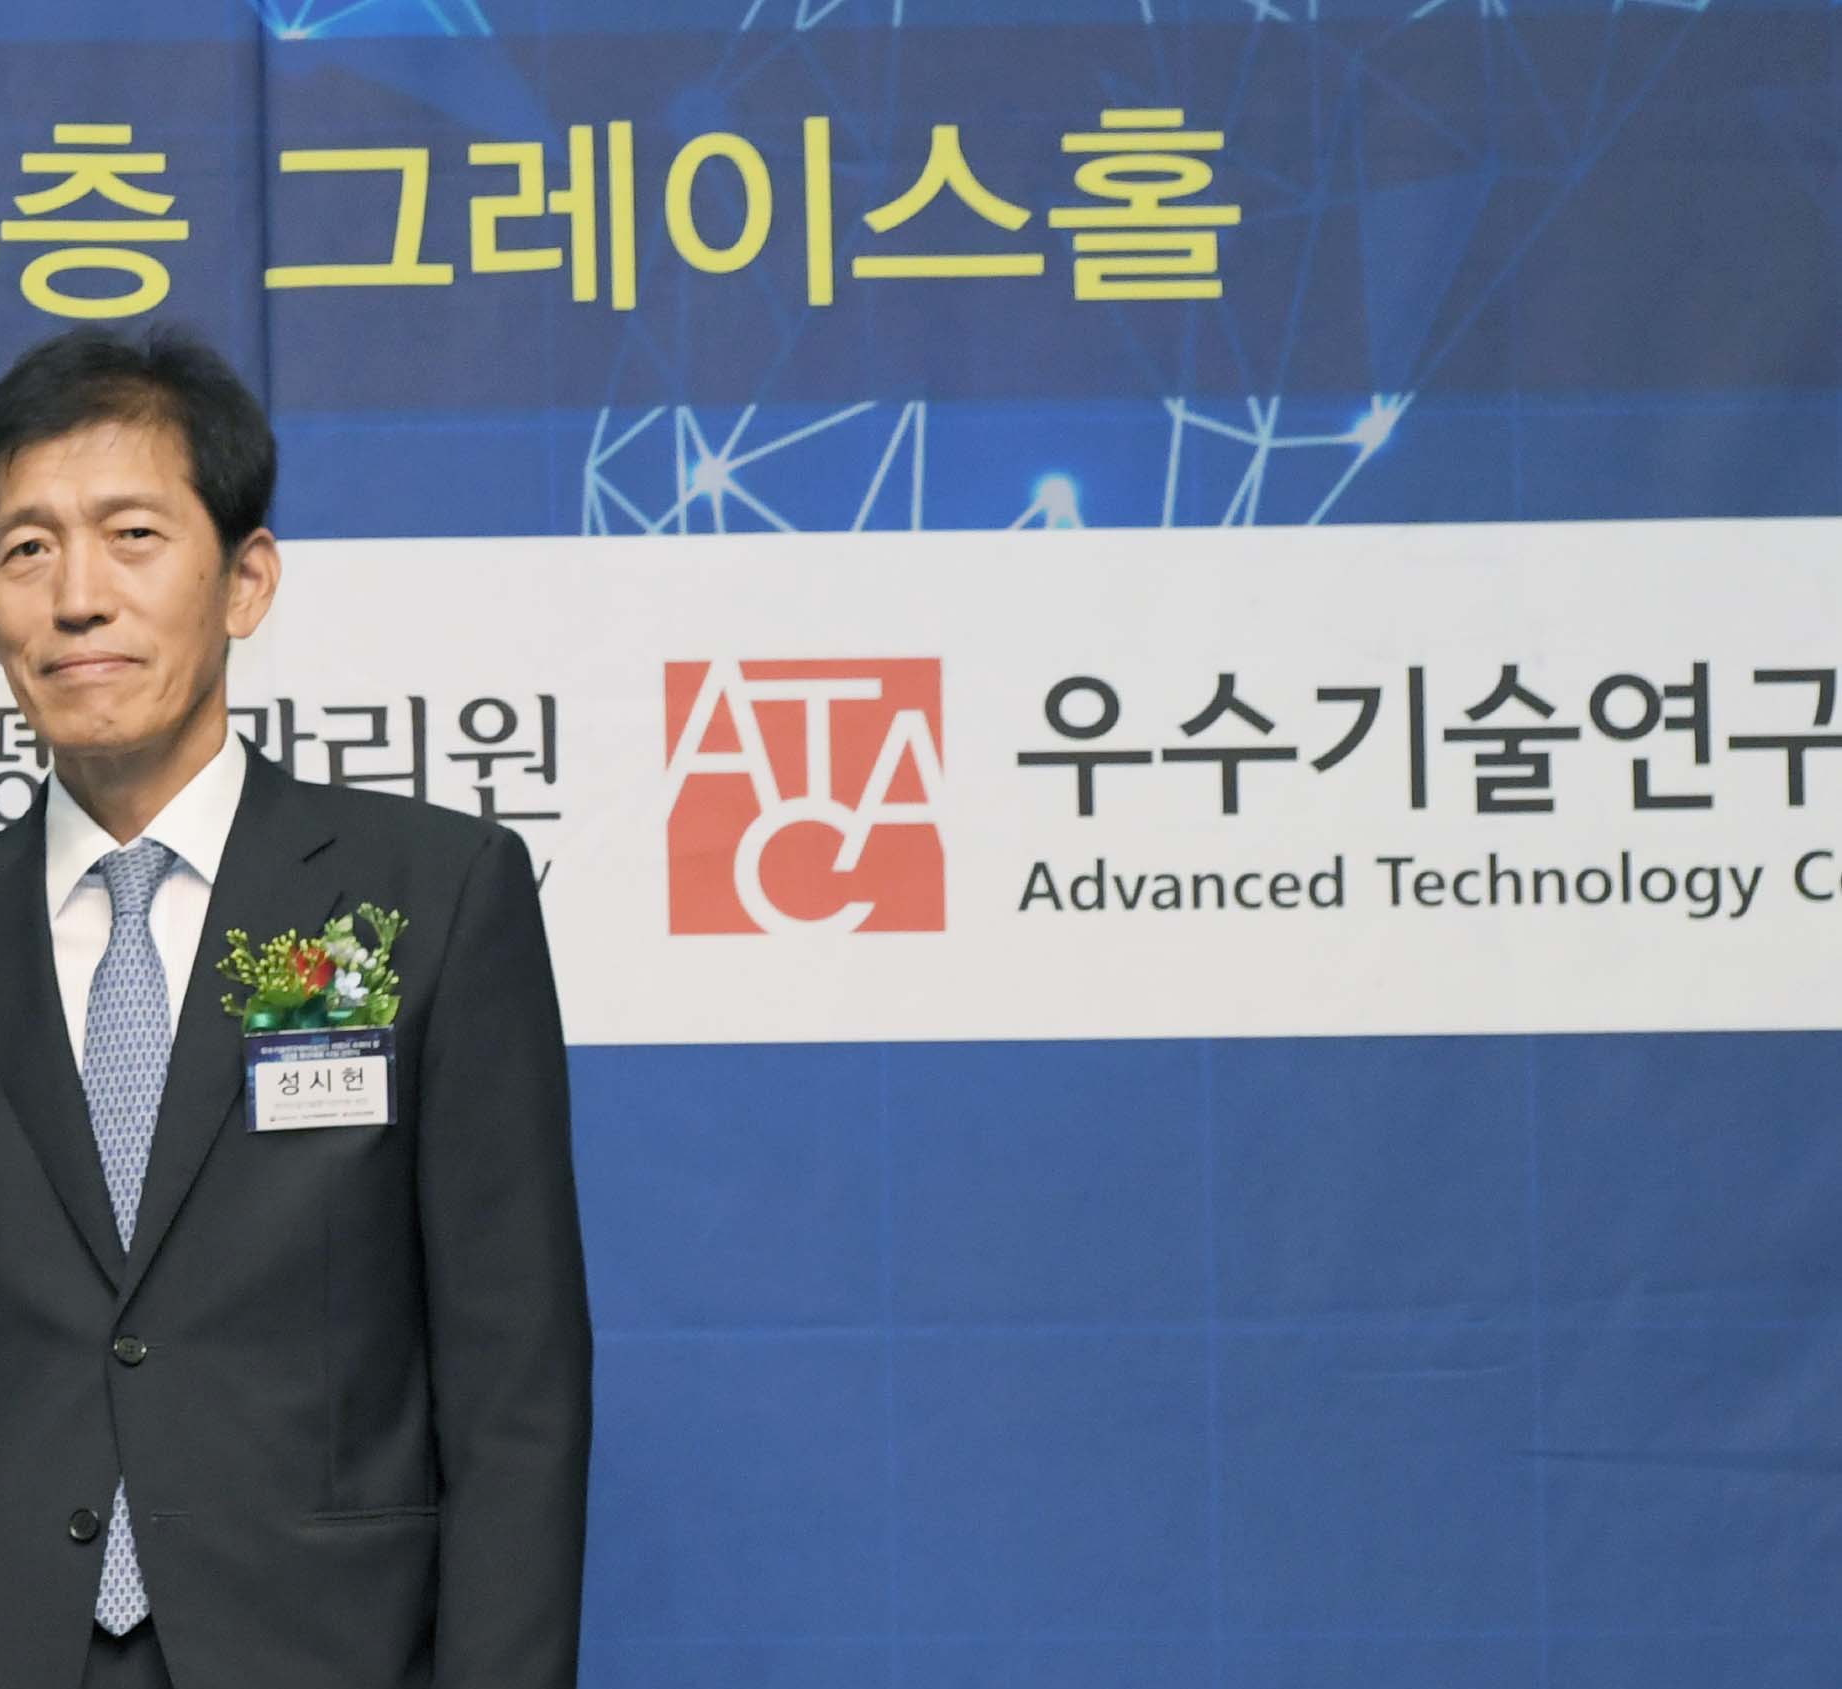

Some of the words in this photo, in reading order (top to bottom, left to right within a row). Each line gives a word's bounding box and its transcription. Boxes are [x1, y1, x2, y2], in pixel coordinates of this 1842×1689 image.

[264, 108, 1243, 310] 그레이스홀
[1018, 855, 1345, 911] Advanced
[1375, 851, 1764, 919] Technology
[1794, 850, 1842, 902] C
